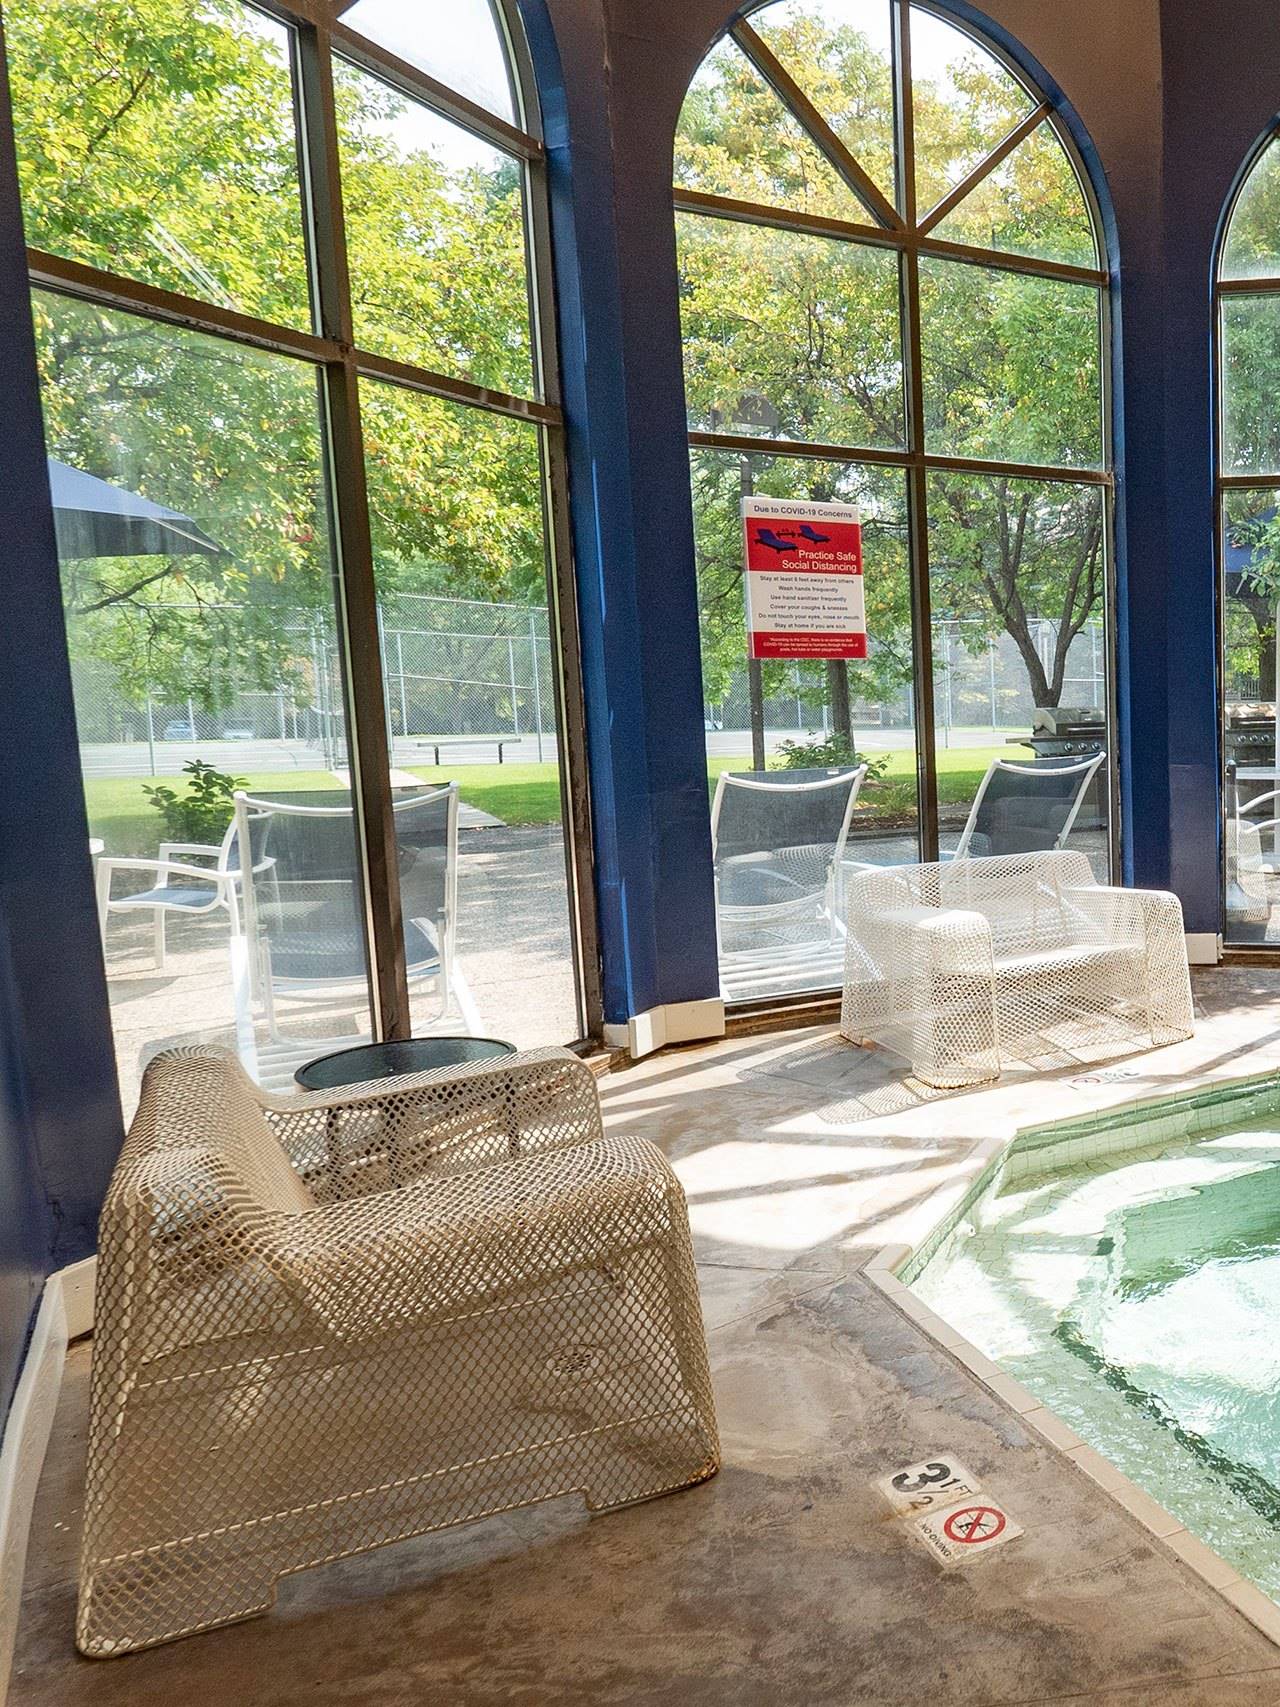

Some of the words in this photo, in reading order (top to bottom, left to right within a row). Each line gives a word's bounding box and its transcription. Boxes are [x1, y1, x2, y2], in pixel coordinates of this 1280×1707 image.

[754, 505, 768, 513] Due
[780, 507, 816, 516] COVID-19
[818, 509, 852, 518] Concerns
[799, 550, 834, 560] Practice
[836, 552, 856, 561] Safe
[782, 560, 809, 569] Social
[812, 561, 857, 573] Distancing
[891, 1462, 951, 1493] 3
[954, 1485, 973, 1496] FT
[920, 1523, 931, 1535] NO
[929, 1534, 952, 1557] DIVING
